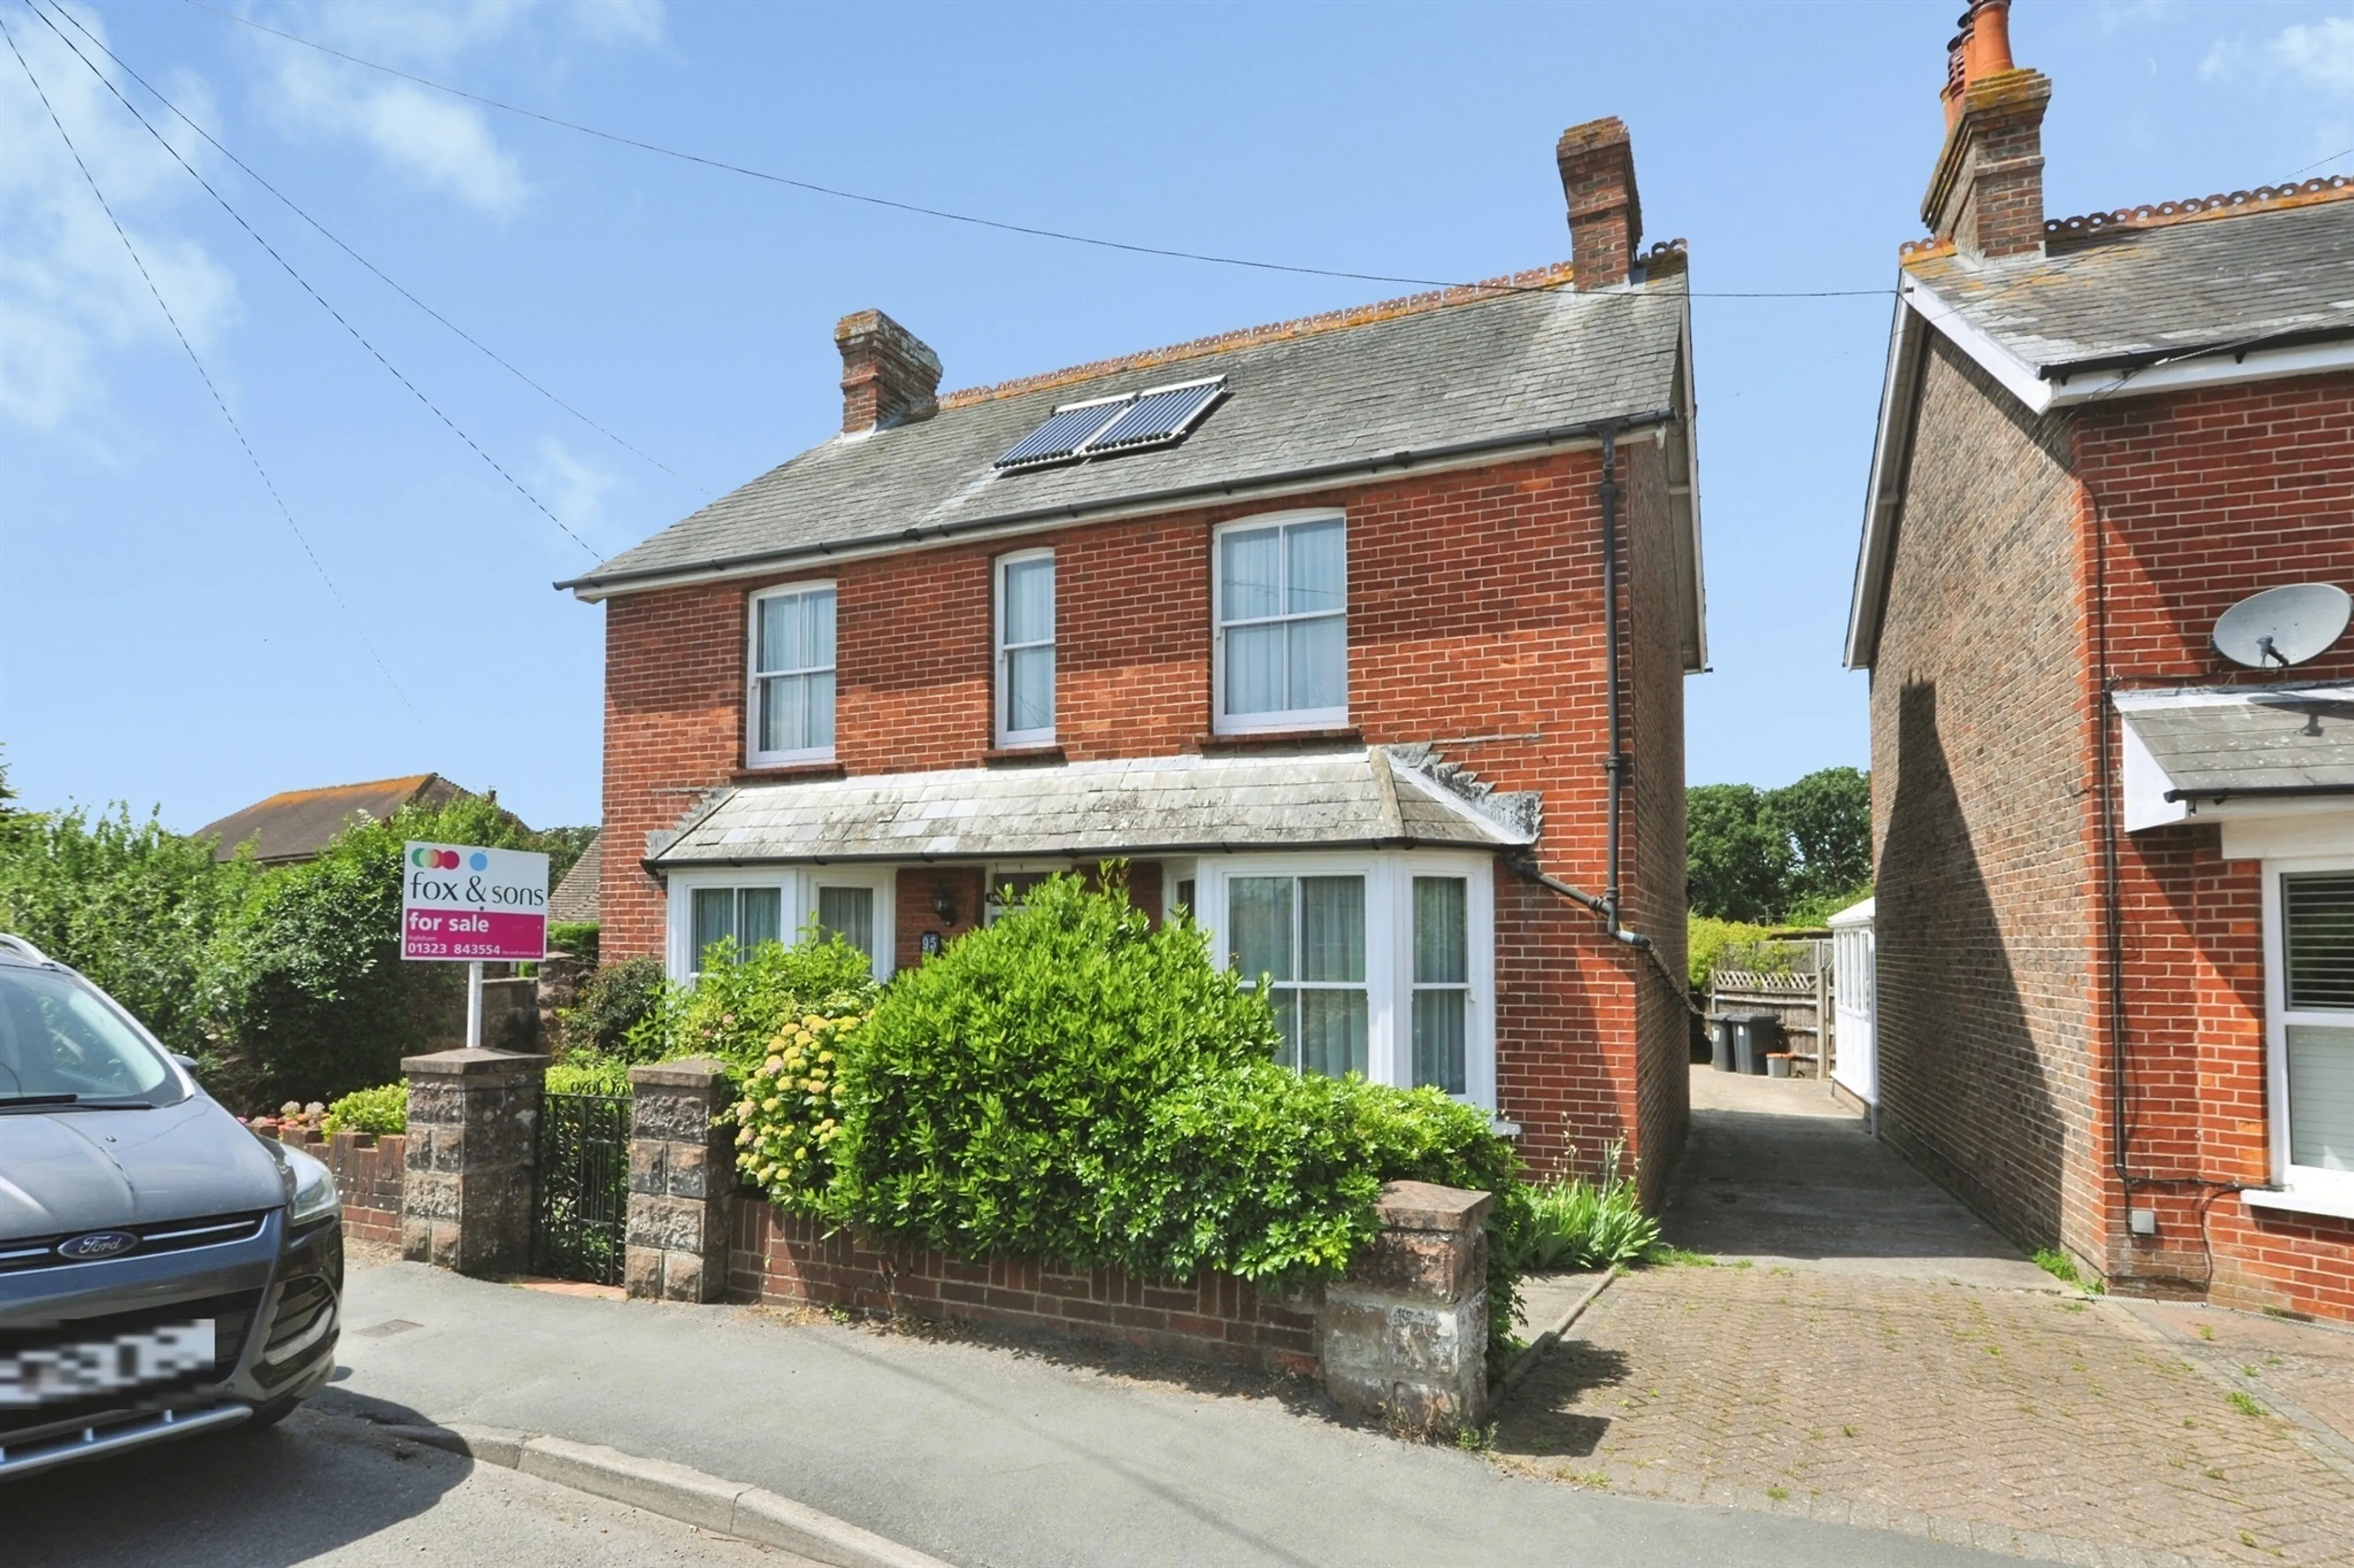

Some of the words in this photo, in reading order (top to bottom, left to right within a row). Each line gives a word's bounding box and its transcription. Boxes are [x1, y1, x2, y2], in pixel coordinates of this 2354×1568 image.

[410, 871, 459, 901] fox
[465, 875, 487, 902] &
[492, 885, 544, 907] sons
[408, 911, 443, 931] for
[448, 915, 490, 932] sale
[408, 942, 447, 954] 01323
[454, 943, 501, 956] 843554
[922, 935, 937, 951] 95
[78, 1235, 123, 1254] Ford
